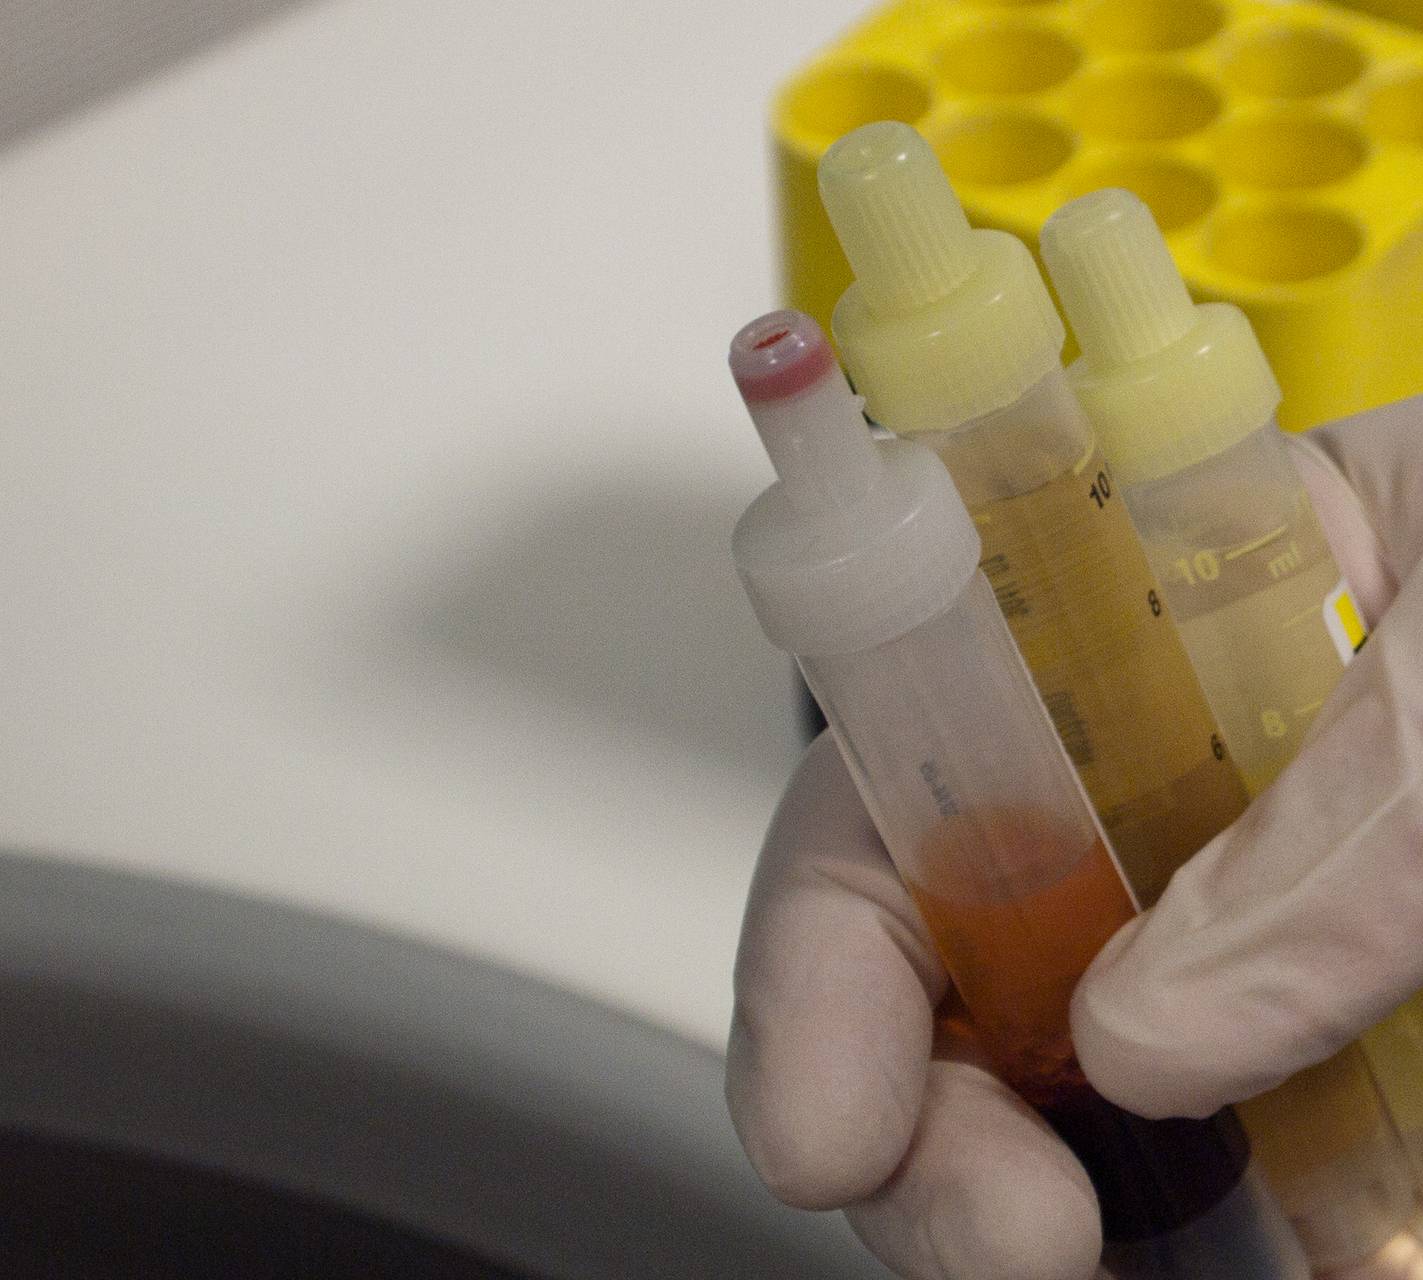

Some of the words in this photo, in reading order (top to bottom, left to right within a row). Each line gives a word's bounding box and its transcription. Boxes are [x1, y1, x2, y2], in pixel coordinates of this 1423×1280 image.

[1089, 471, 1111, 509] 10
[1175, 550, 1220, 585] 10
[1147, 588, 1162, 617] 8
[1209, 733, 1224, 761] 6
